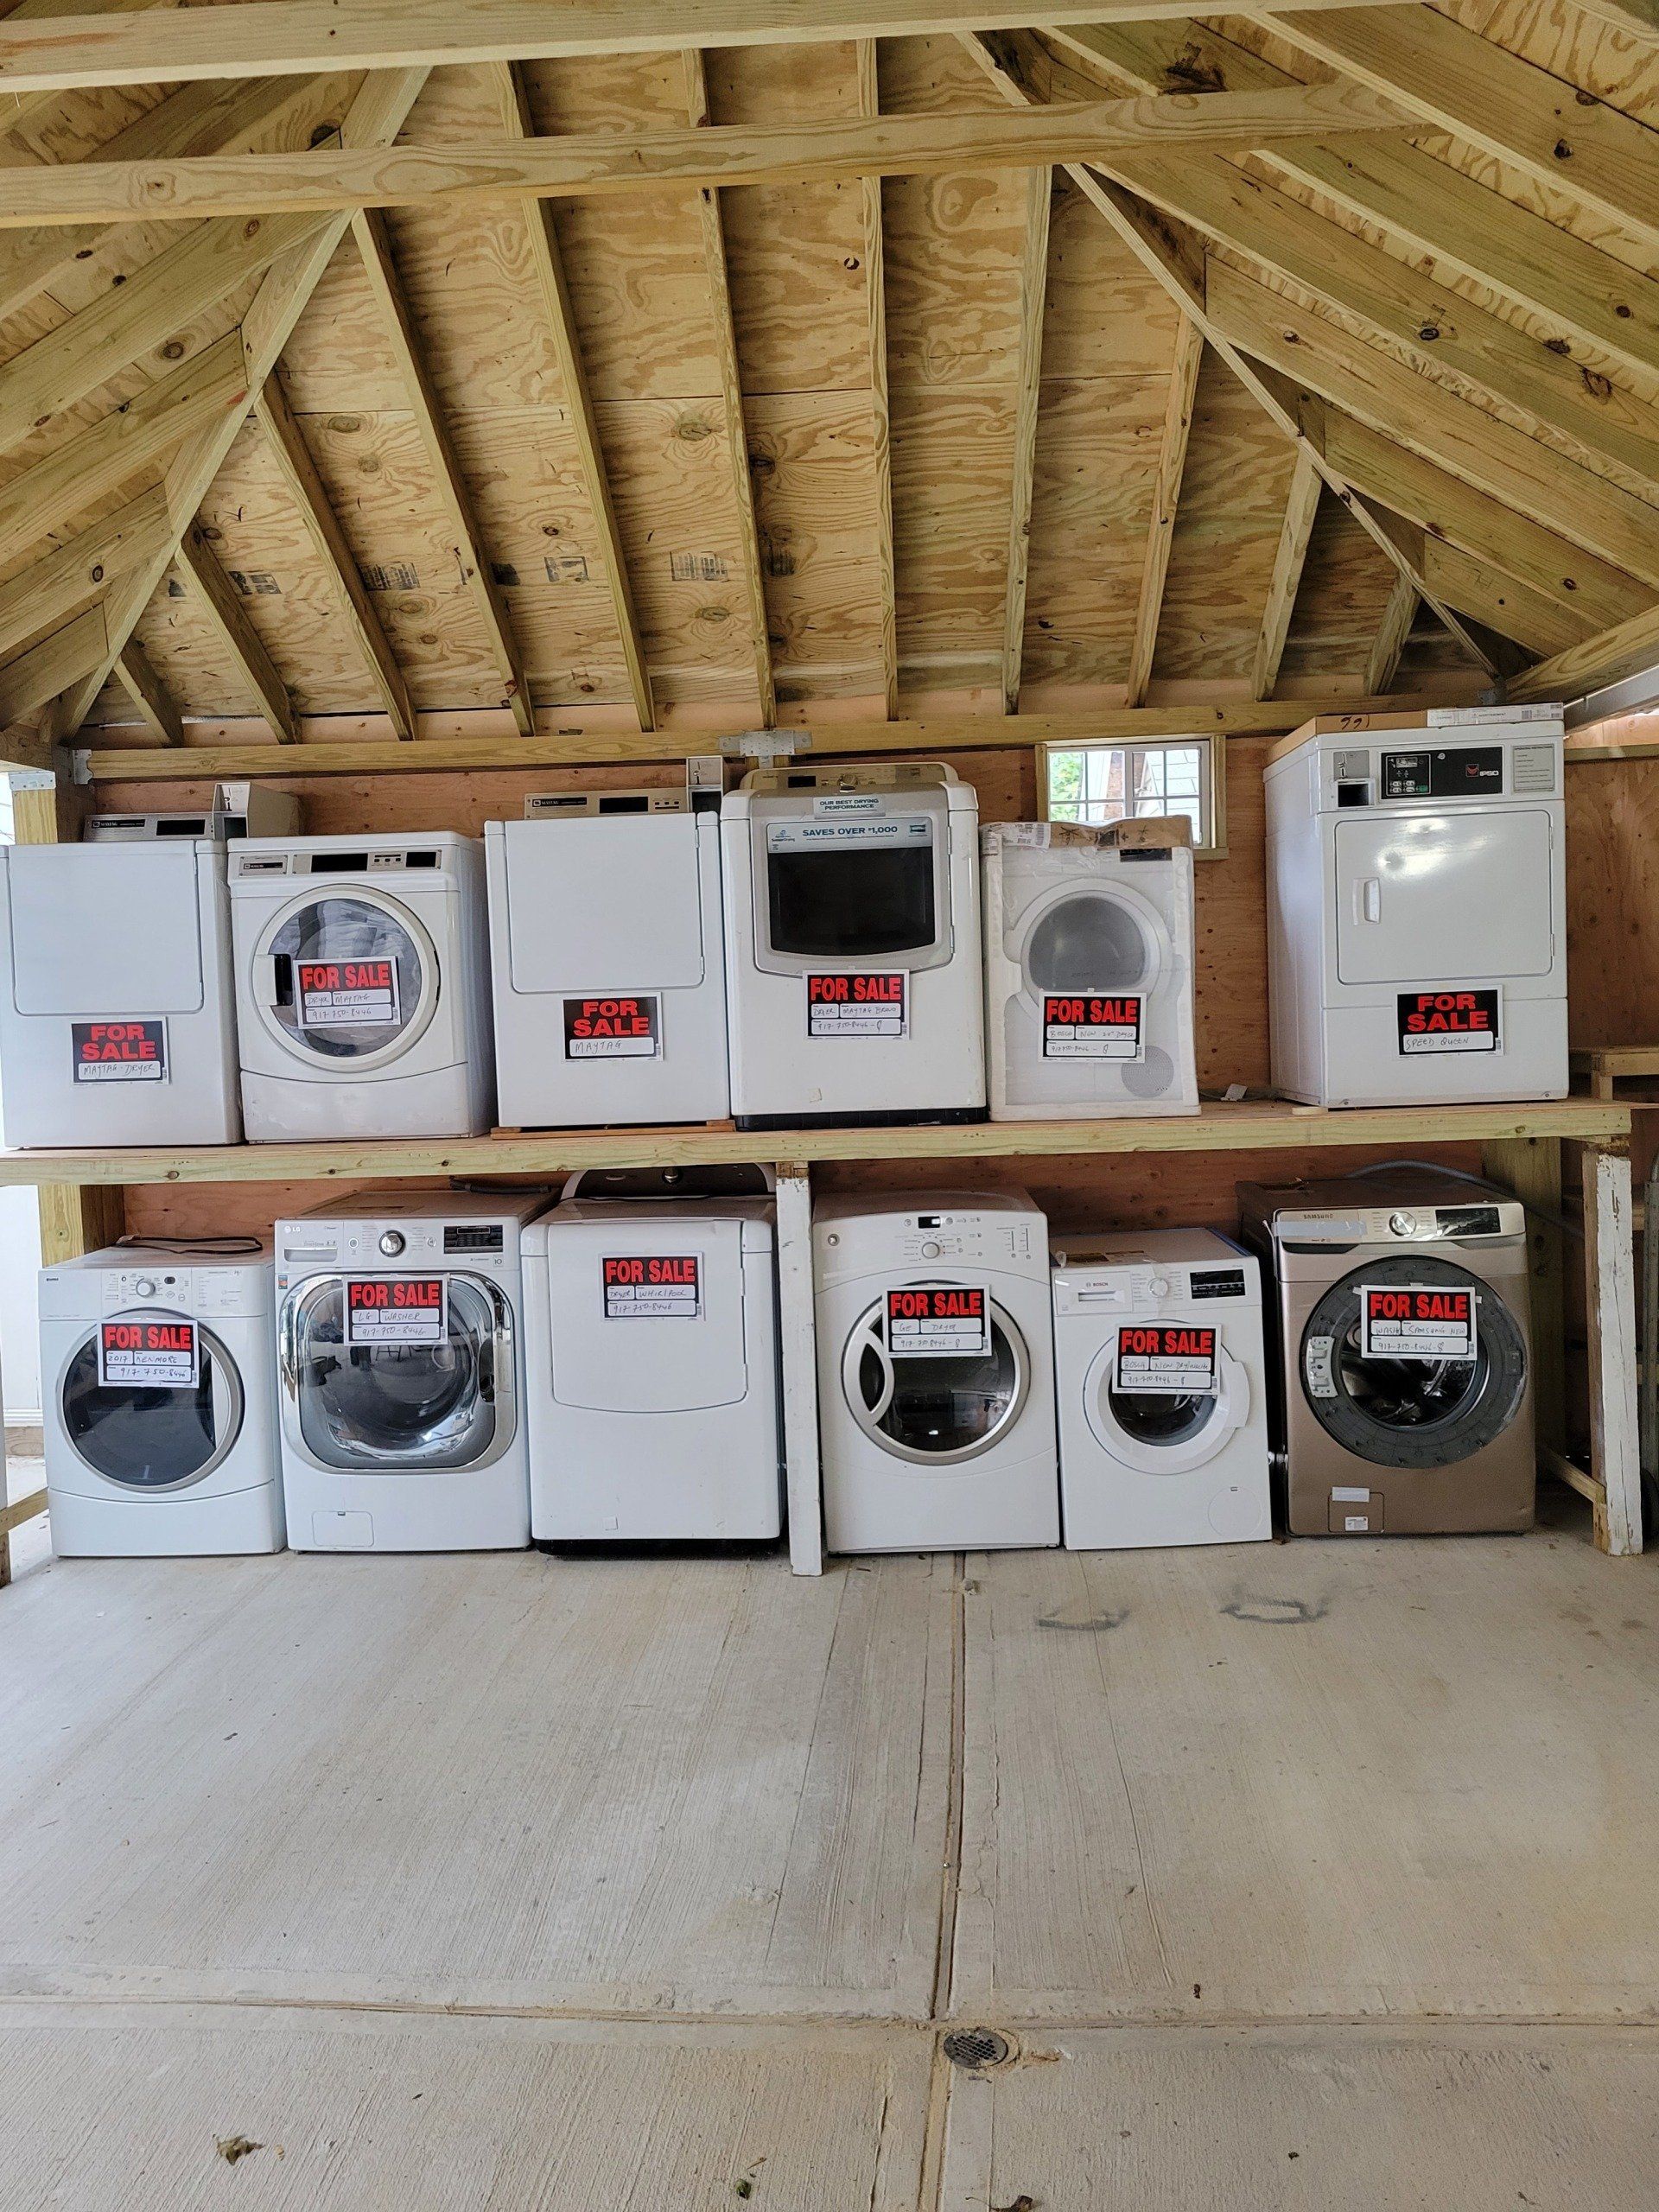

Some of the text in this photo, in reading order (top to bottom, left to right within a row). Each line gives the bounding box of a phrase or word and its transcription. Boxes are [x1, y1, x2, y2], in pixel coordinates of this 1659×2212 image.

[868, 825, 898, 834] $1,000
[302, 963, 391, 989] FOR SALE
[810, 977, 901, 1001] FOR SALE
[582, 1000, 639, 1017] FOR
[1046, 1000, 1137, 1023] FOR SALE
[1418, 994, 1476, 1012] FOR
[573, 1017, 650, 1037] SALE
[1407, 1010, 1489, 1032] SALE
[91, 1024, 145, 1041] FOR
[81, 1041, 156, 1061] SALE
[575, 1039, 621, 1054] MAYTAG
[1406, 1036, 1469, 1051] SPEED QUEEN
[84, 1064, 118, 1077] MAYTAG
[606, 1259, 696, 1283] FOR SALE
[351, 1283, 440, 1307] FOR SALE
[890, 1292, 982, 1317] FOR SALE
[1370, 1294, 1468, 1319] FOR SALE
[359, 1312, 421, 1322] LG WASHER
[105, 1325, 192, 1349] FOR SALE
[1122, 1331, 1212, 1354] FOR SALE
[108, 1355, 128, 1363] 2017
